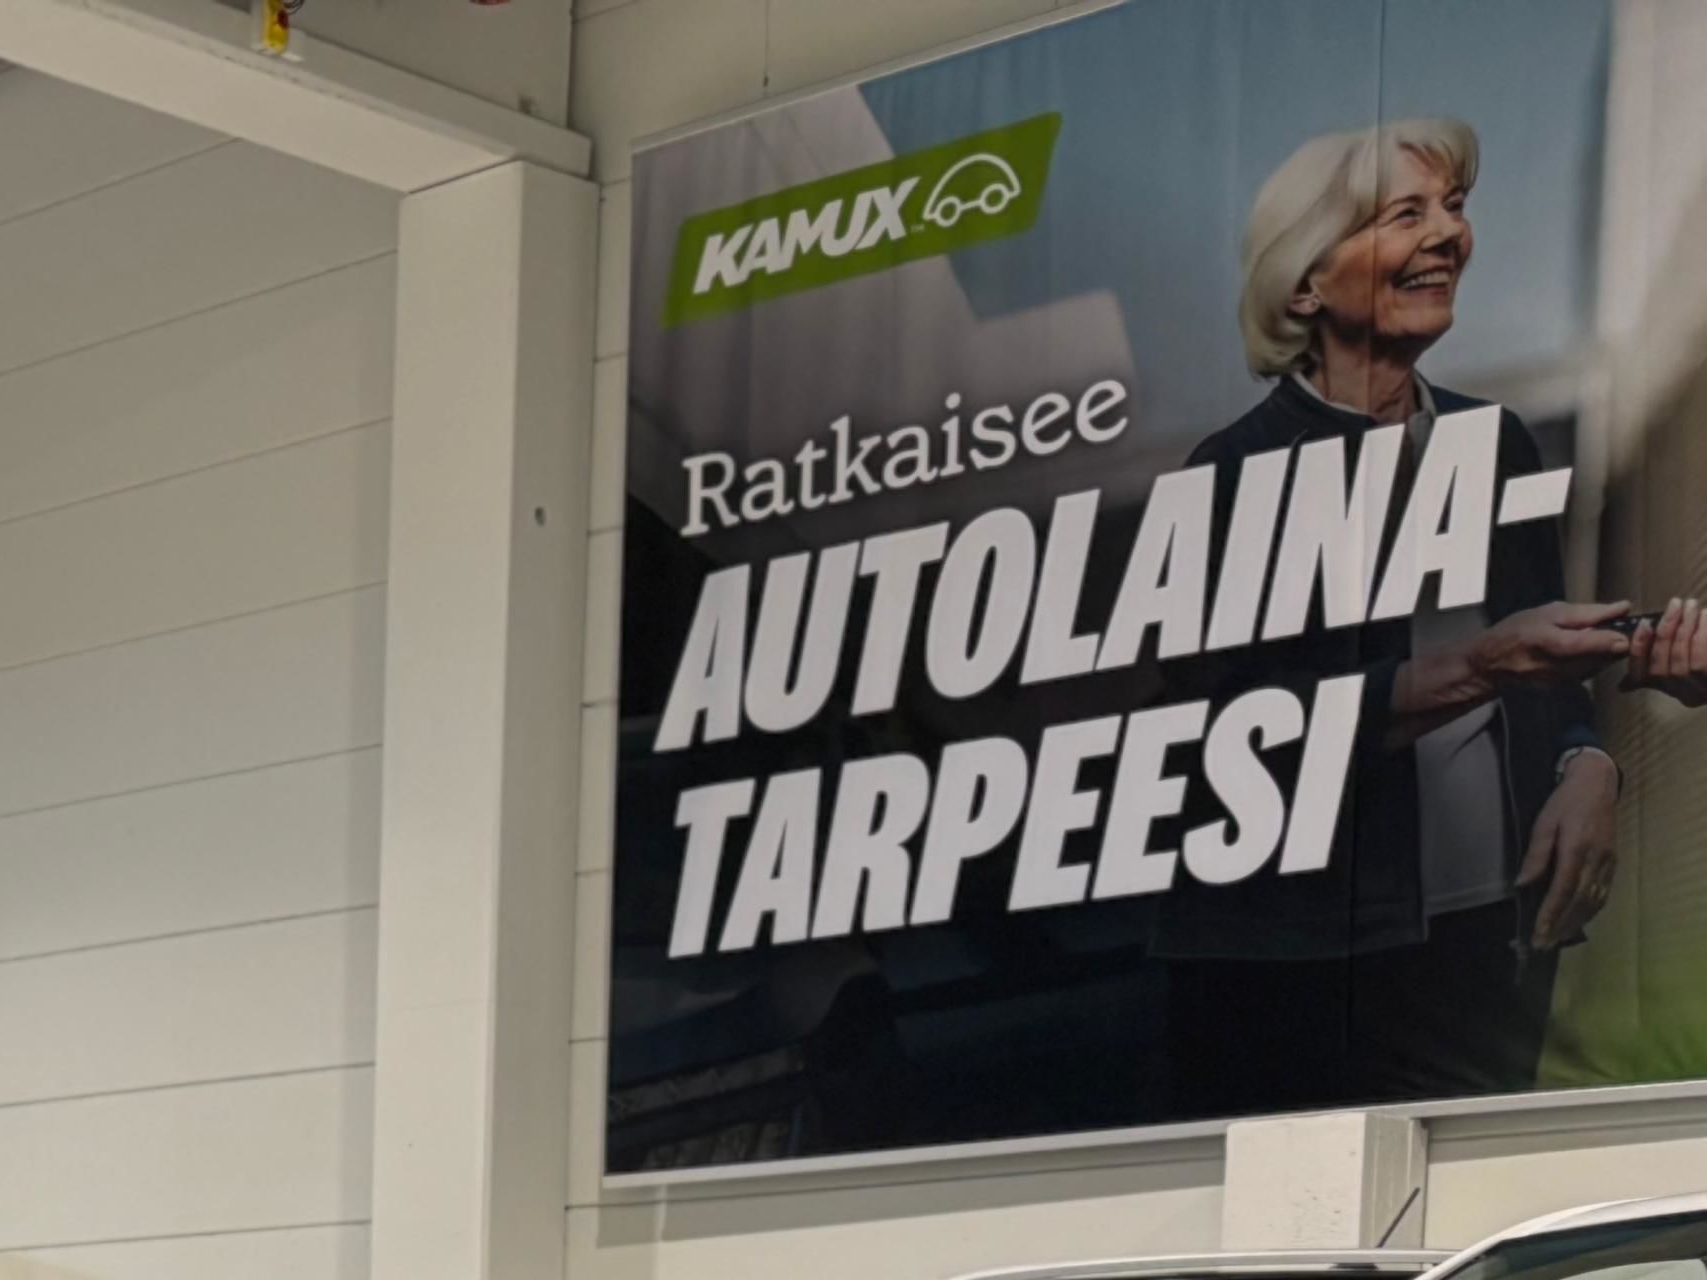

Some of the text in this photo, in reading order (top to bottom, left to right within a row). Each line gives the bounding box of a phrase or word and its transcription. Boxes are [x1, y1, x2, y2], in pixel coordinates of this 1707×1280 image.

[693, 176, 921, 294] KAMUX
[680, 379, 1128, 537] Ratkaisee
[652, 404, 1573, 753] AUTOLAINA-
[667, 673, 1365, 959] TARPEESI
